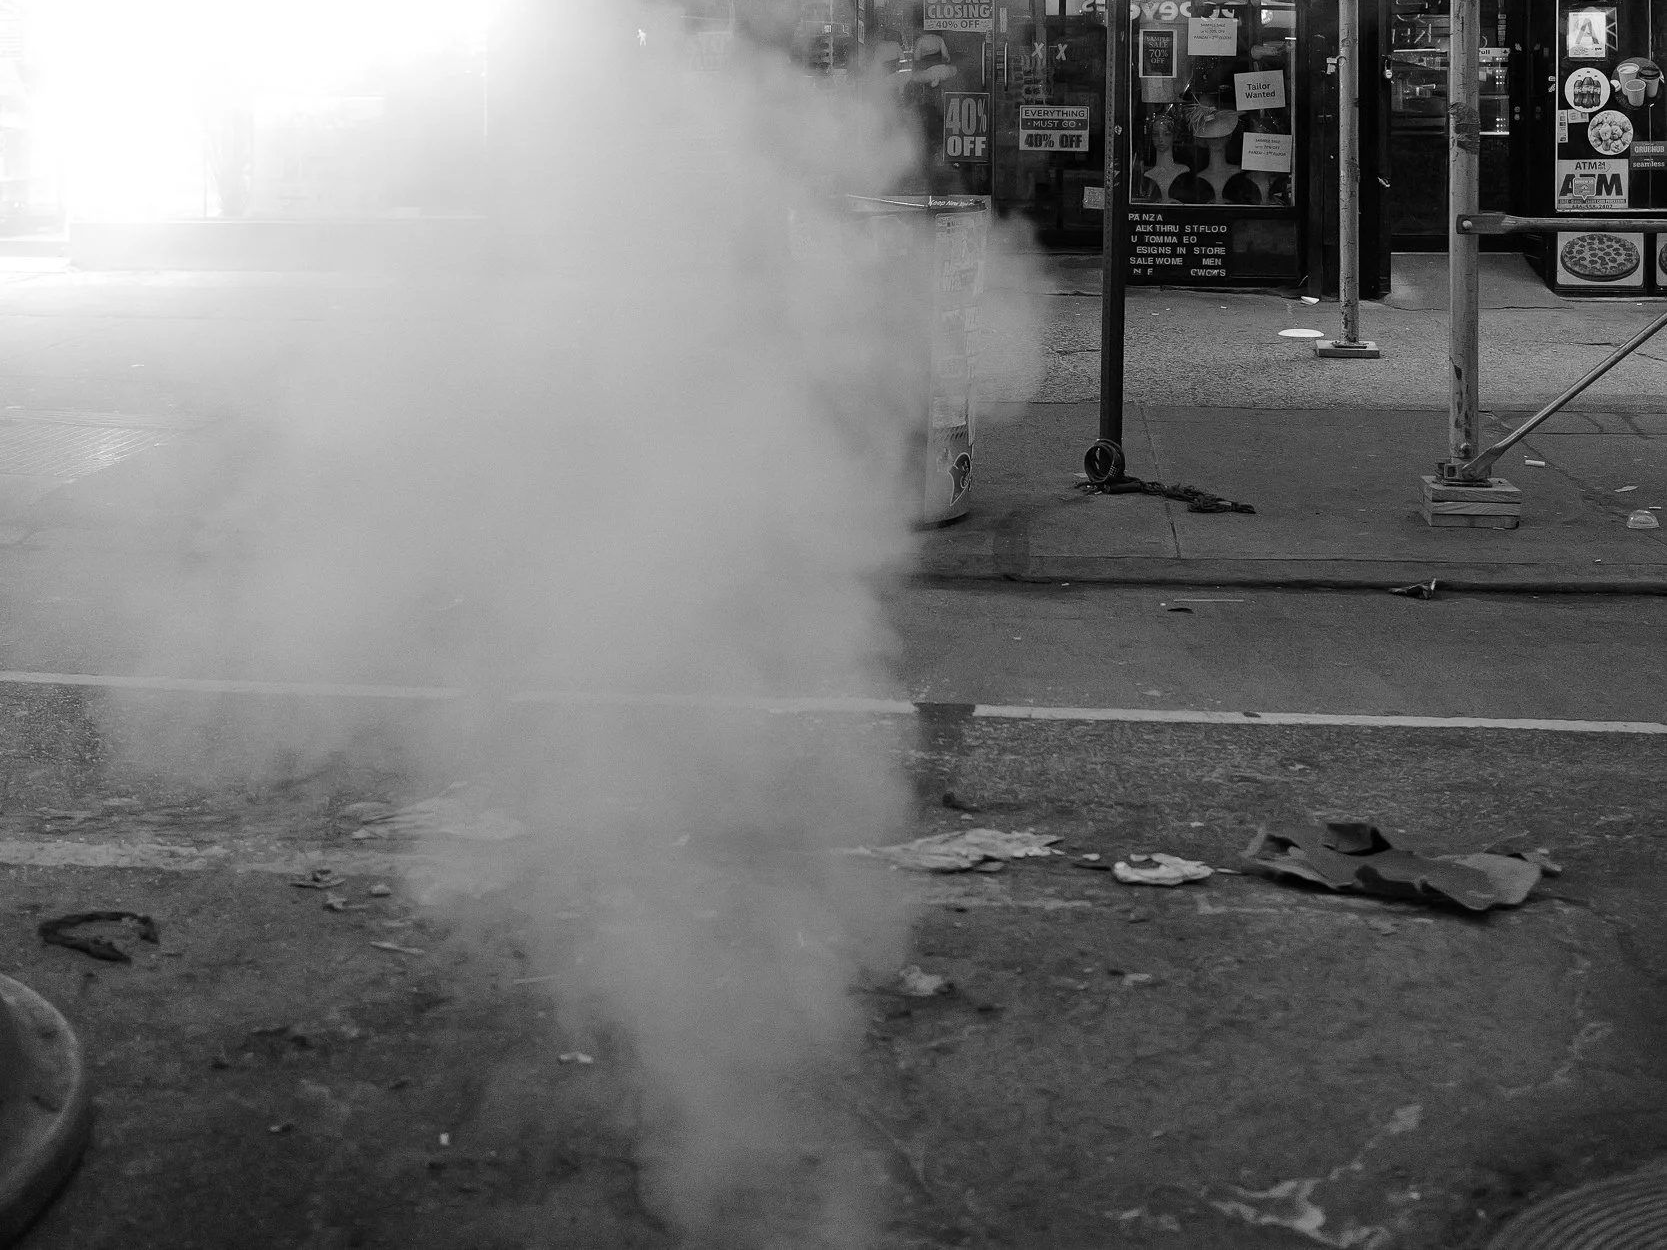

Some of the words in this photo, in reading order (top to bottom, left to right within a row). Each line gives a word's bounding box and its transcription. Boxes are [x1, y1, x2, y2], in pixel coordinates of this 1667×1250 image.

[928, 4, 990, 19] CLOSING
[936, 20, 959, 29] 40%
[960, 20, 980, 29] OFF
[1148, 49, 1169, 58] 70%
[1246, 82, 1271, 91] Tailor
[1244, 90, 1276, 99] Wanted
[945, 98, 988, 135] 40%
[1024, 109, 1085, 117] EVERYTHING
[1033, 120, 1059, 128] MUST
[1061, 120, 1077, 128] GO
[1024, 134, 1055, 147] 40%
[1060, 134, 1083, 148] OFF
[946, 136, 988, 157] OFF
[1574, 161, 1598, 170] ATM
[1632, 160, 1666, 168] seamless
[1559, 173, 1624, 196] AM
[1135, 224, 1153, 232] ALK
[1155, 224, 1179, 232] THRU
[1136, 246, 1172, 254] ESIGNS
[1176, 246, 1186, 255] IN
[1193, 246, 1226, 255] STORE
[1129, 257, 1154, 265] SALE
[1202, 257, 1222, 266] MEN
